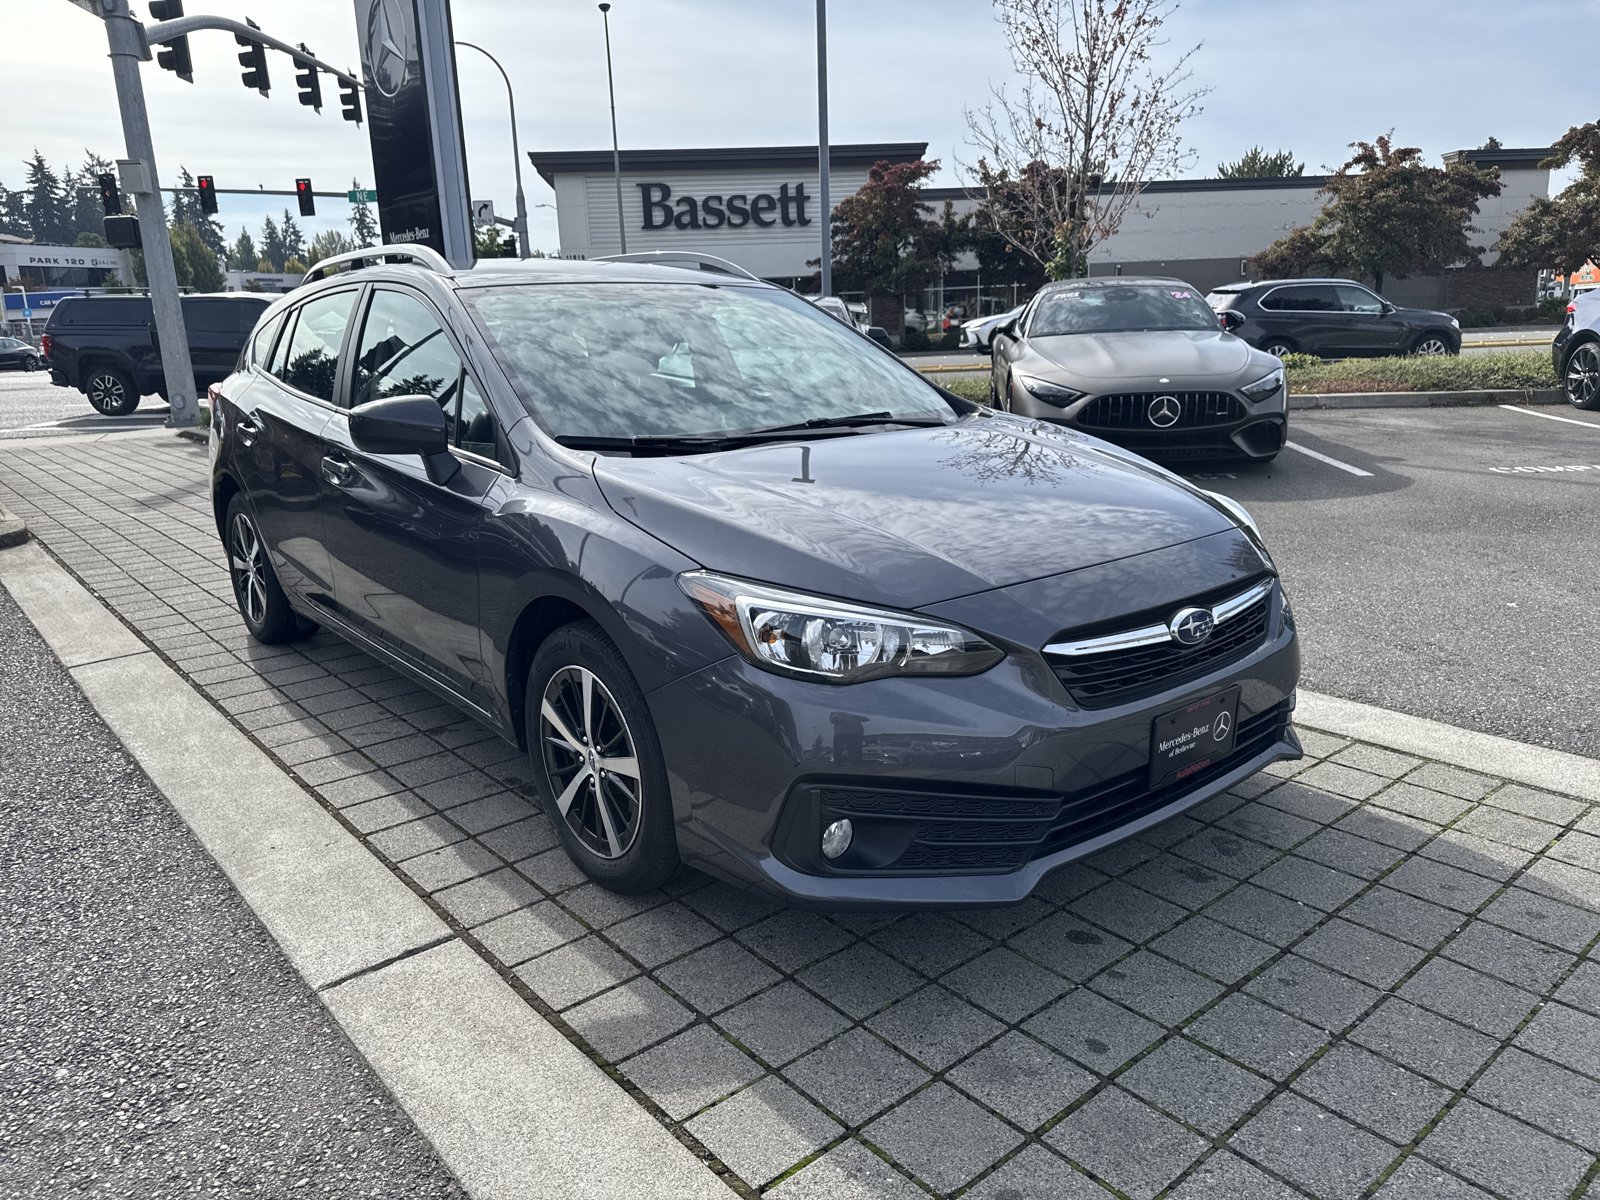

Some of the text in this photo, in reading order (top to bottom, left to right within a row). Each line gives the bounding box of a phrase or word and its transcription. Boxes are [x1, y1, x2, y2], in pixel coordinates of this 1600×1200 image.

[357, 191, 369, 201] NE
[636, 182, 812, 230] Bassett
[389, 227, 429, 243] Mercedes-Benz
[29, 257, 60, 265] PARK
[1488, 464, 1600, 473] COMP
[1158, 724, 1210, 753] Mercedes-Benz
[1168, 742, 1196, 758] of Bellevue
